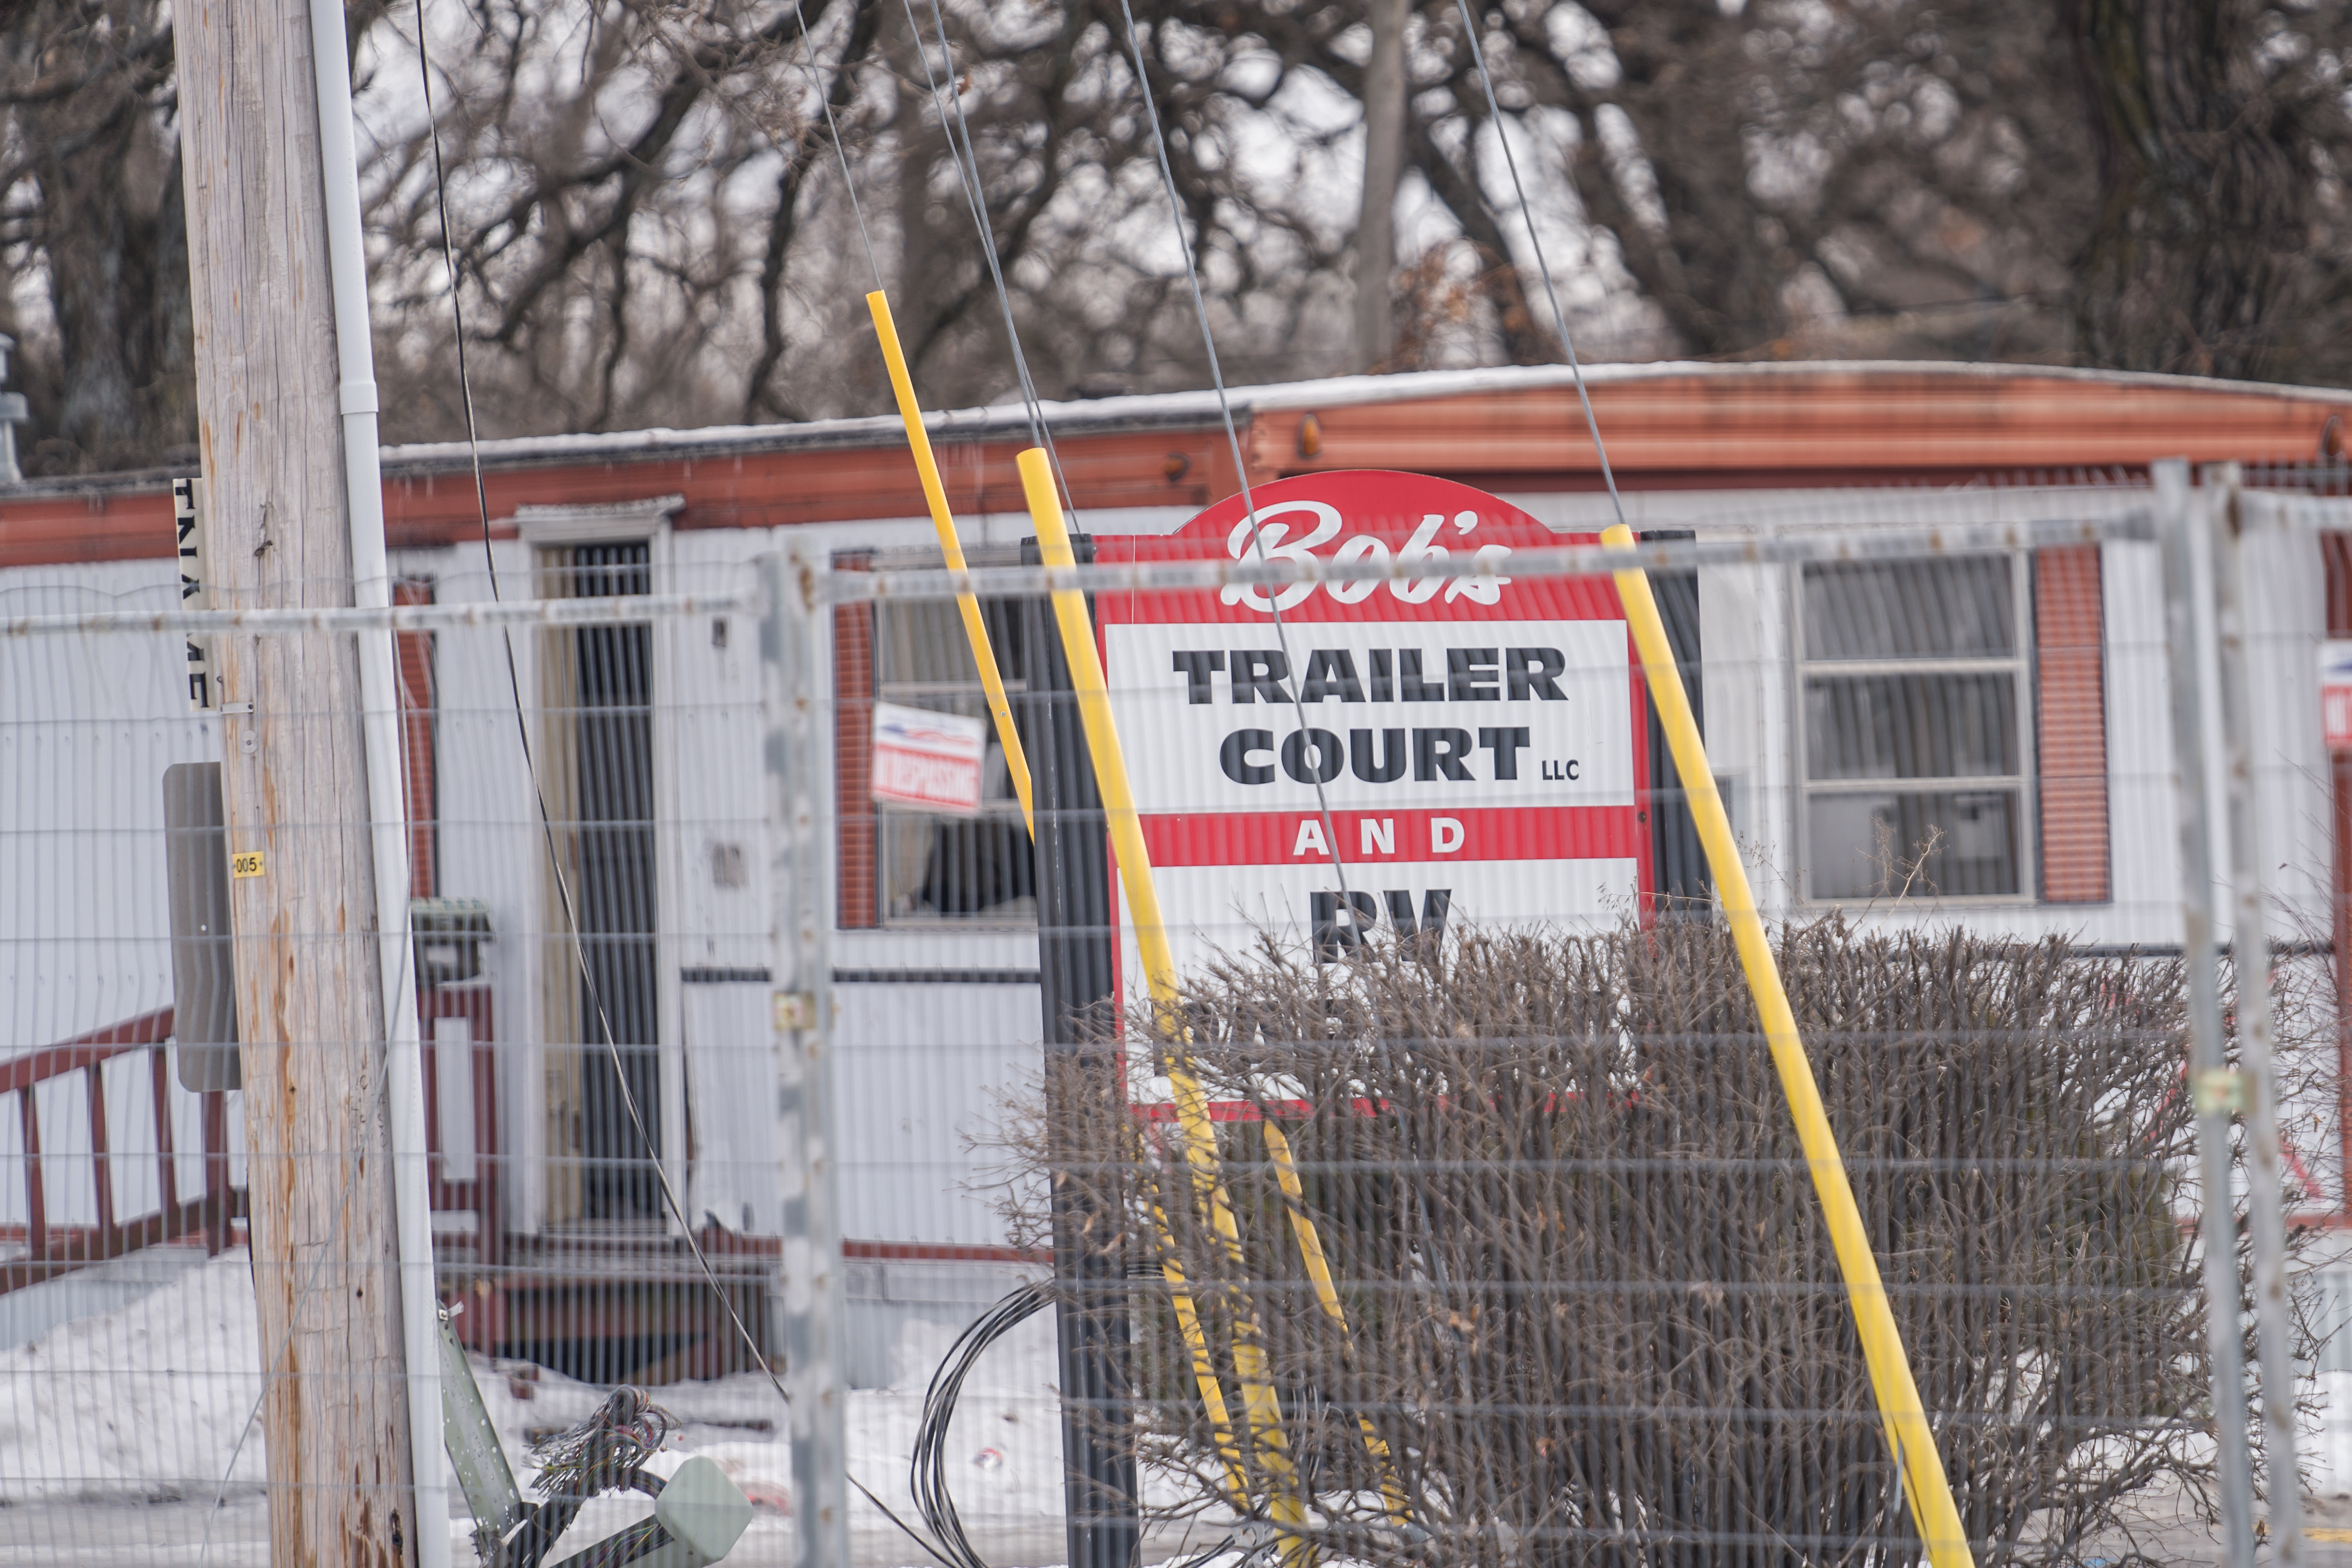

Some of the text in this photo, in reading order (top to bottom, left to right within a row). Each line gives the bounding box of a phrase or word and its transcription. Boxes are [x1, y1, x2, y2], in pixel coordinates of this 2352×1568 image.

[1220, 500, 1512, 612] Bob's
[1172, 647, 1569, 705] TRAILER
[1219, 727, 1579, 785] COURT LLC
[237, 857, 257, 872] 005
[1292, 817, 1465, 856] AND
[1310, 889, 1452, 964] RV
